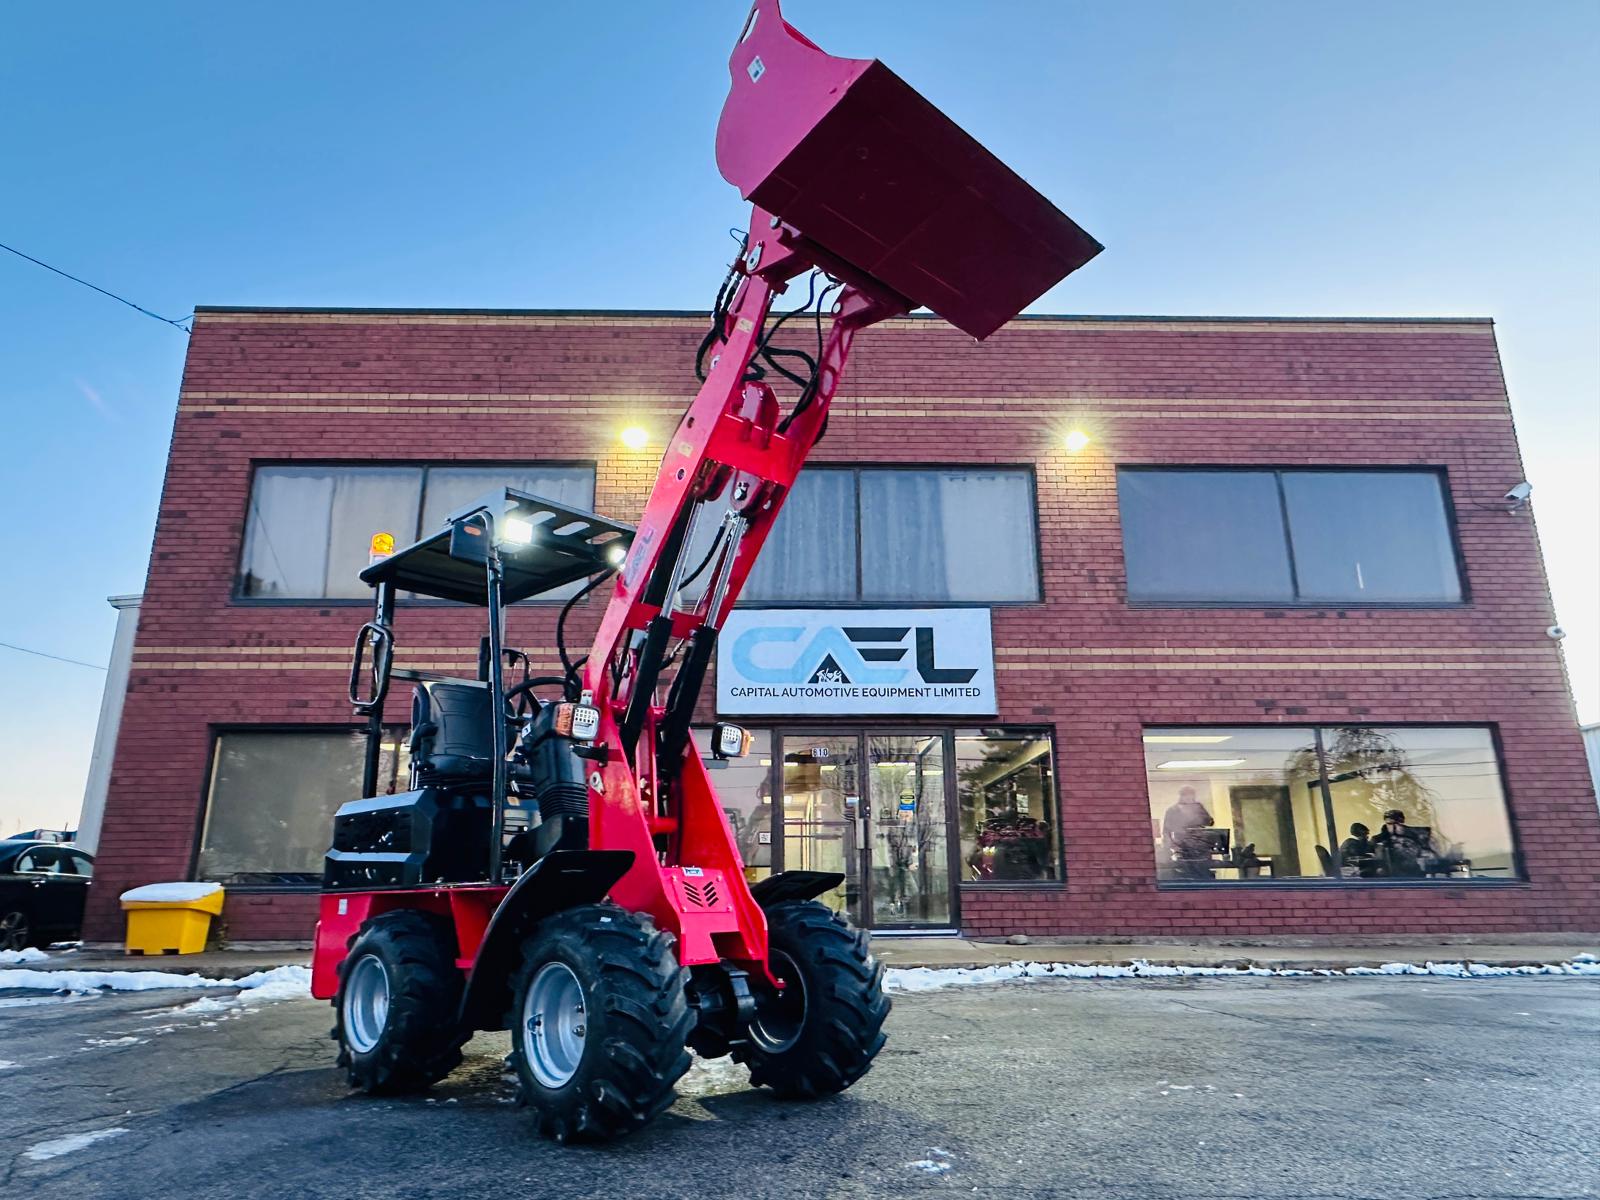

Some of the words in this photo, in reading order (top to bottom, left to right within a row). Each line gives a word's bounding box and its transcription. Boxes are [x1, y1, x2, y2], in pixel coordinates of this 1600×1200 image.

[731, 626, 979, 684] CAEL
[730, 687, 780, 698] CAPITAL
[781, 687, 860, 698] AUTOMOTIVE
[861, 687, 932, 698] EQUIPMENT
[933, 687, 981, 698] LIMITED
